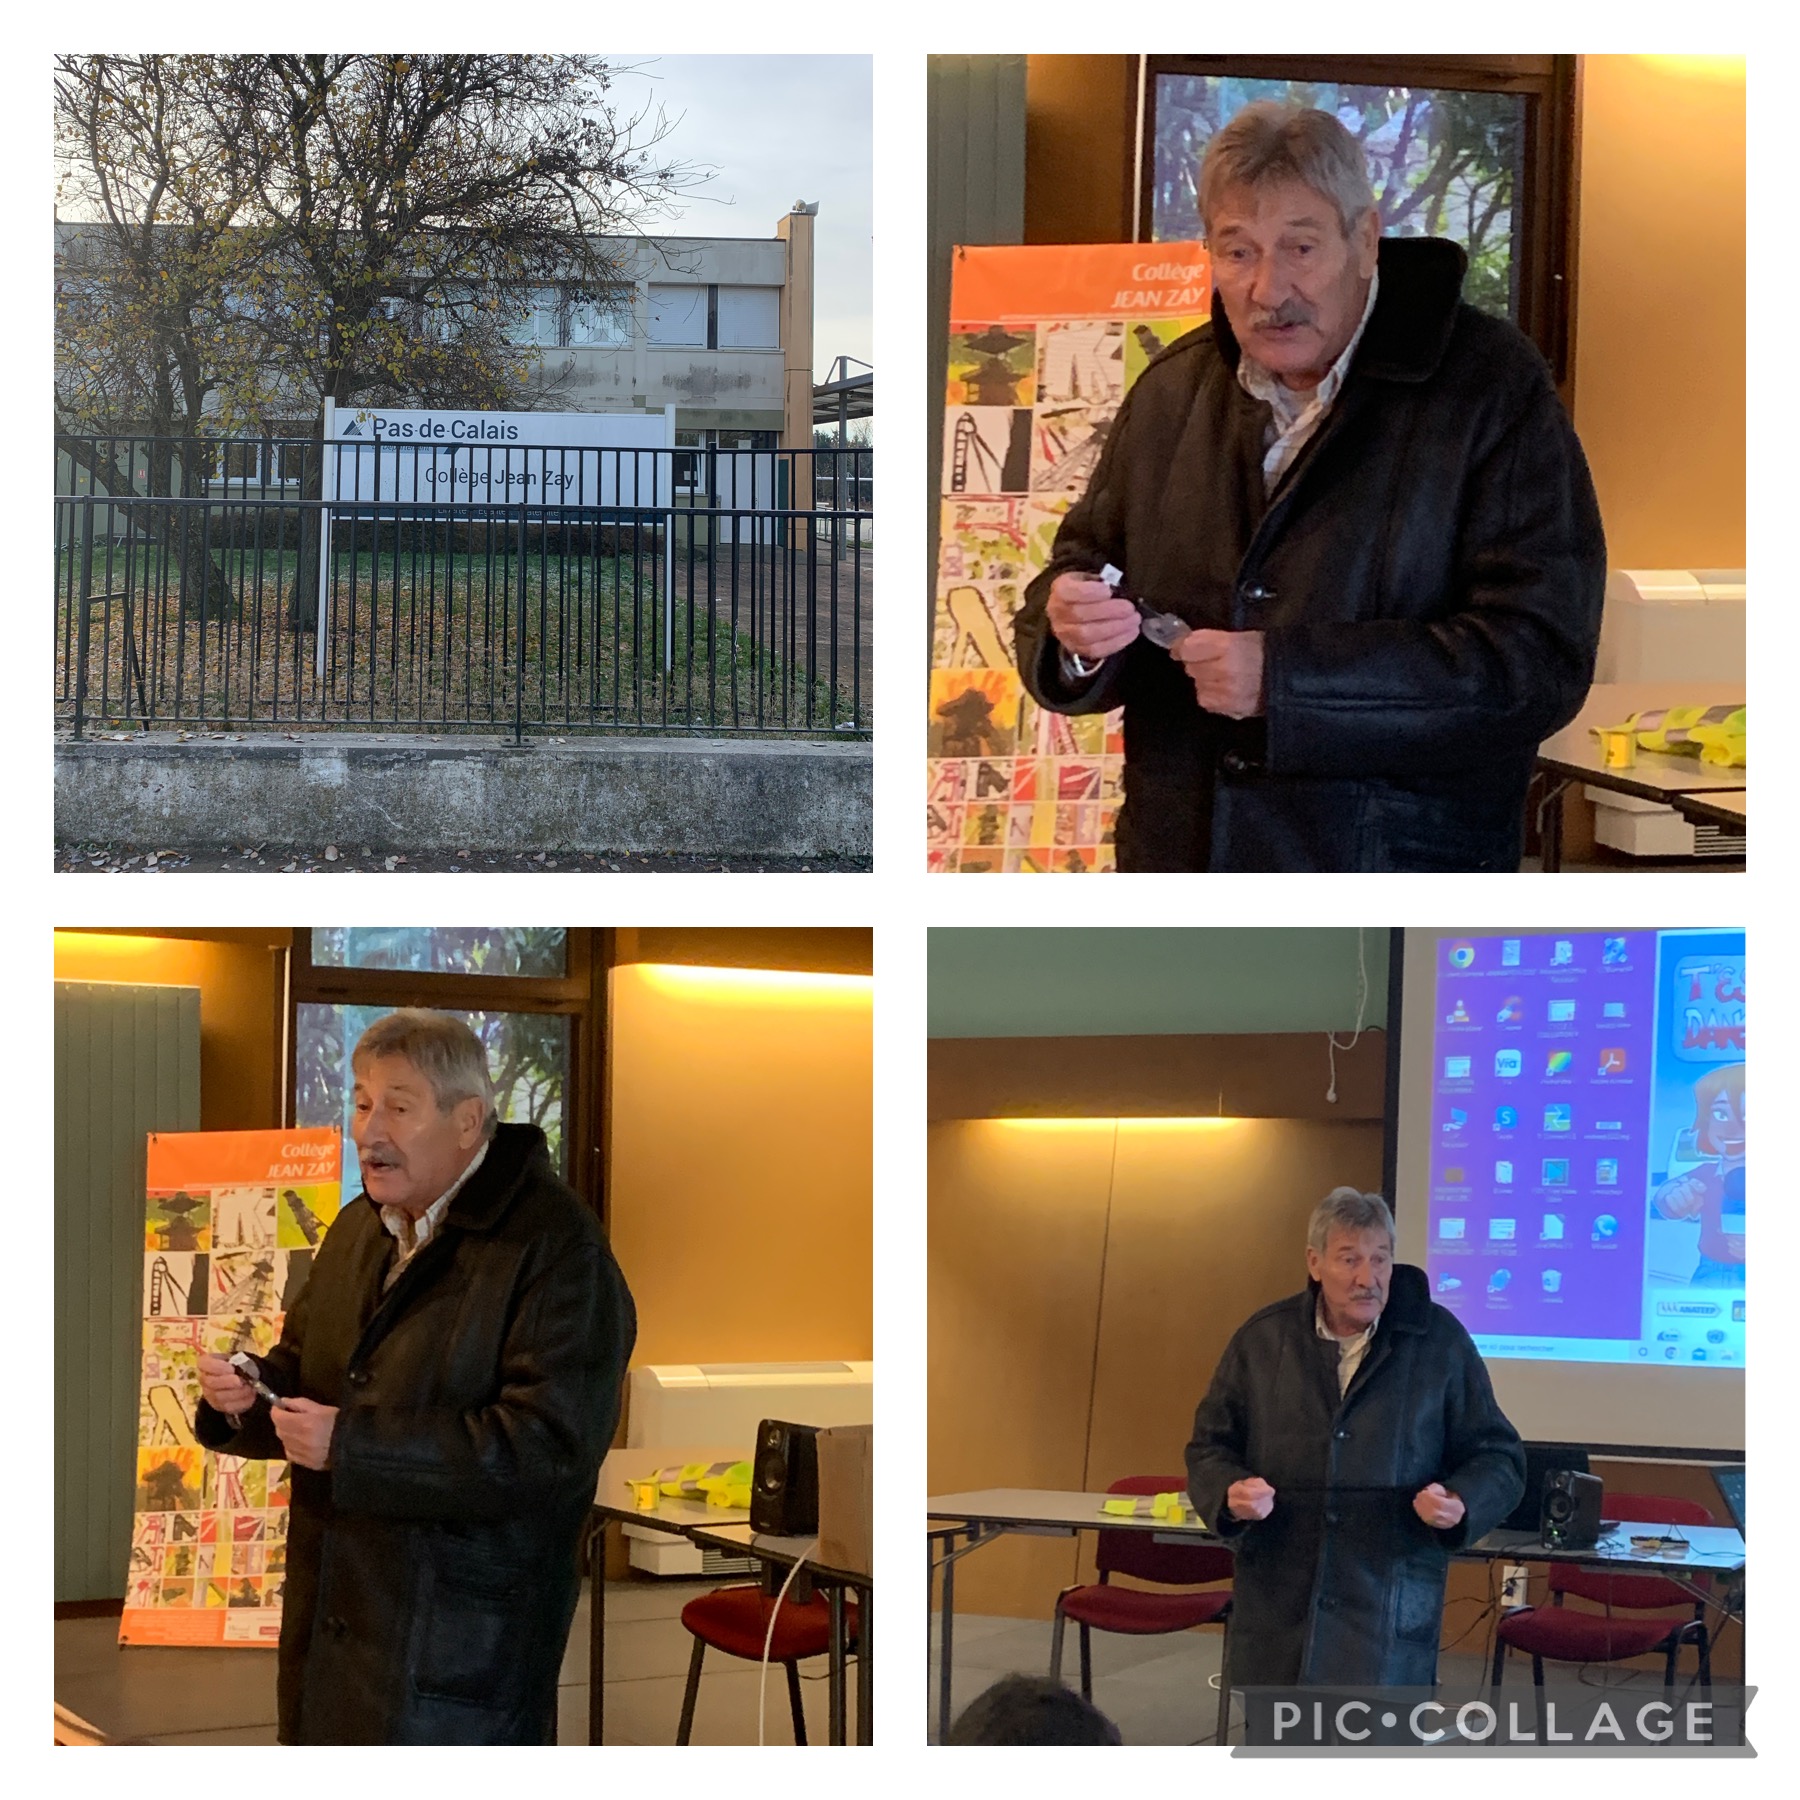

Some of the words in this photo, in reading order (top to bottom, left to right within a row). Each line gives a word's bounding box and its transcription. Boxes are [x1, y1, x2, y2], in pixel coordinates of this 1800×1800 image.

[1132, 262, 1205, 285] Collège
[1110, 290, 1162, 308] JEAN
[1165, 287, 1206, 307] ZAY
[494, 470, 537, 485] Jean
[543, 470, 574, 490] Zay
[281, 1143, 336, 1161] Collège
[265, 1163, 304, 1178] JEAN
[306, 1161, 336, 1176] ZAY
